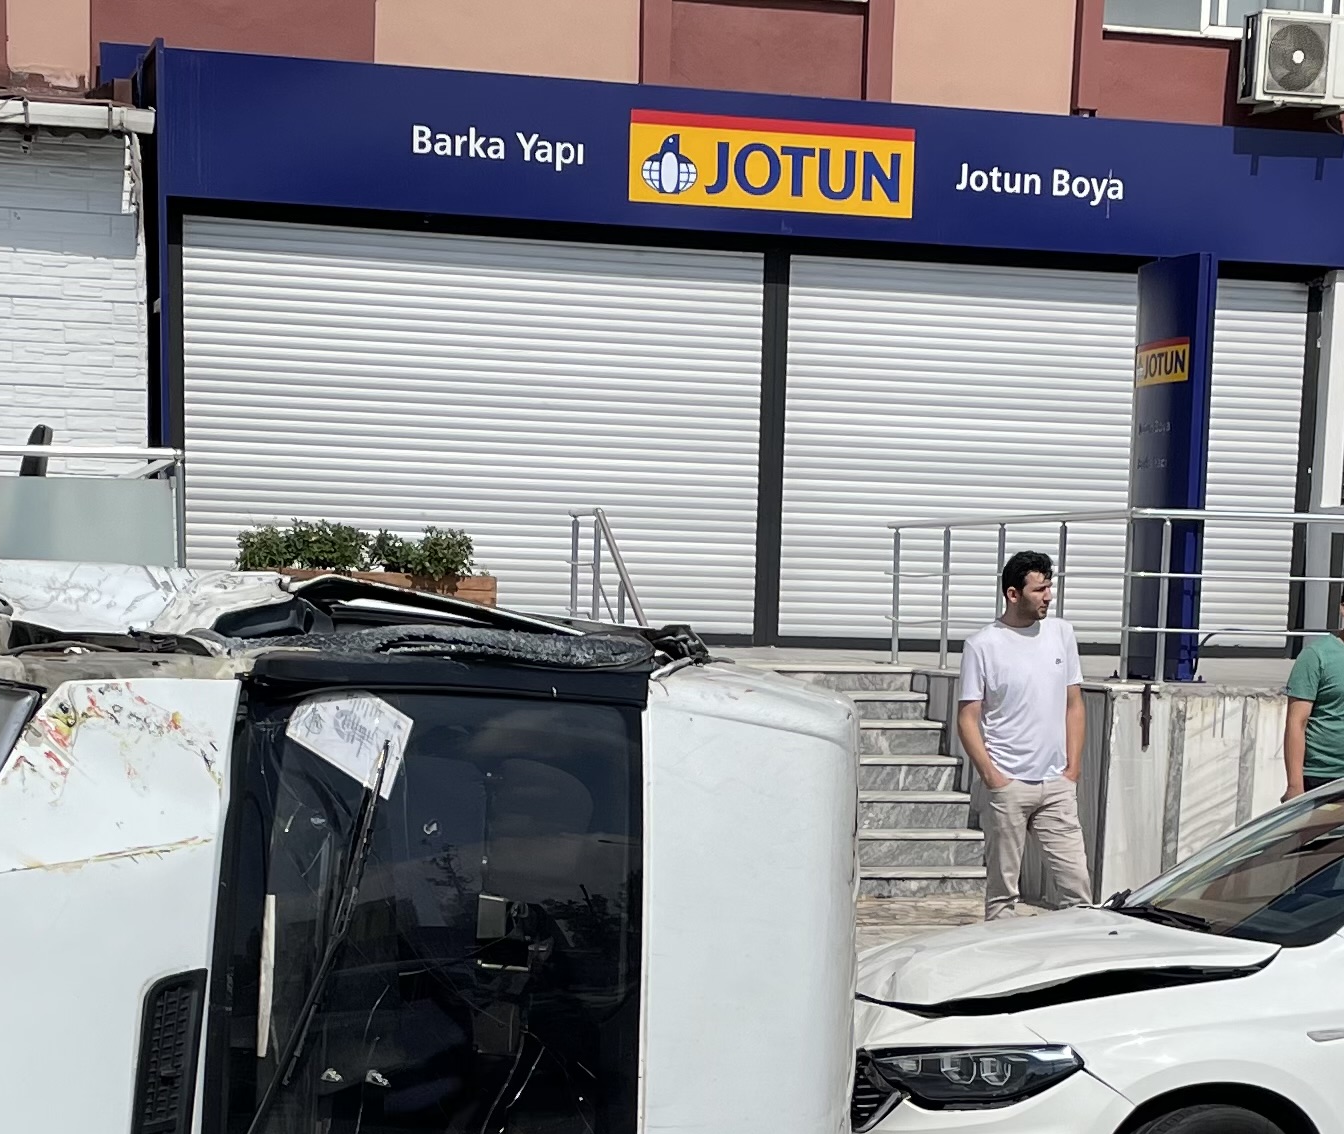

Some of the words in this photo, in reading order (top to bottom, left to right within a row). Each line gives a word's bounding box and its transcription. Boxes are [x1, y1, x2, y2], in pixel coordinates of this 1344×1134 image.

[411, 124, 506, 160] Barka
[516, 131, 585, 171] Yapı
[703, 140, 902, 204] JOTUN
[955, 162, 1041, 196] Jotun
[1052, 168, 1124, 207] Boya
[1143, 348, 1187, 380] JOTUN
